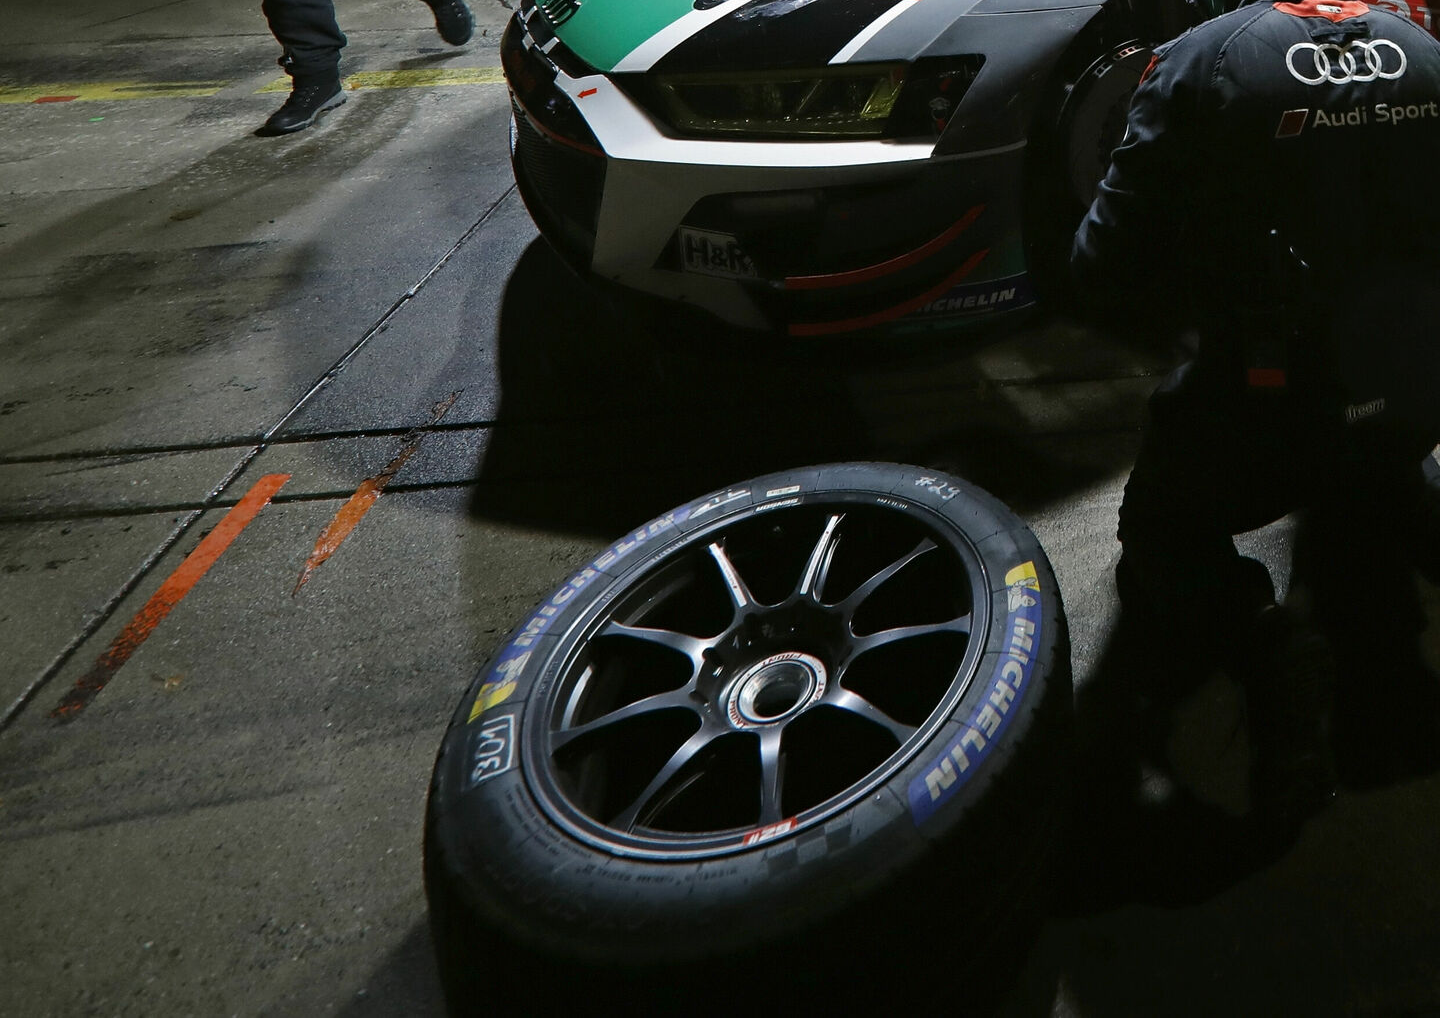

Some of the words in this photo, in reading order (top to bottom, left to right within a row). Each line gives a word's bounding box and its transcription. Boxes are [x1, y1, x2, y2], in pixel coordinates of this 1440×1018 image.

[1312, 106, 1368, 128] Audi
[1374, 100, 1439, 127] Sport
[915, 477, 960, 501] #29
[514, 513, 675, 647] MICHELIN
[924, 617, 1035, 802] MICHELIN
